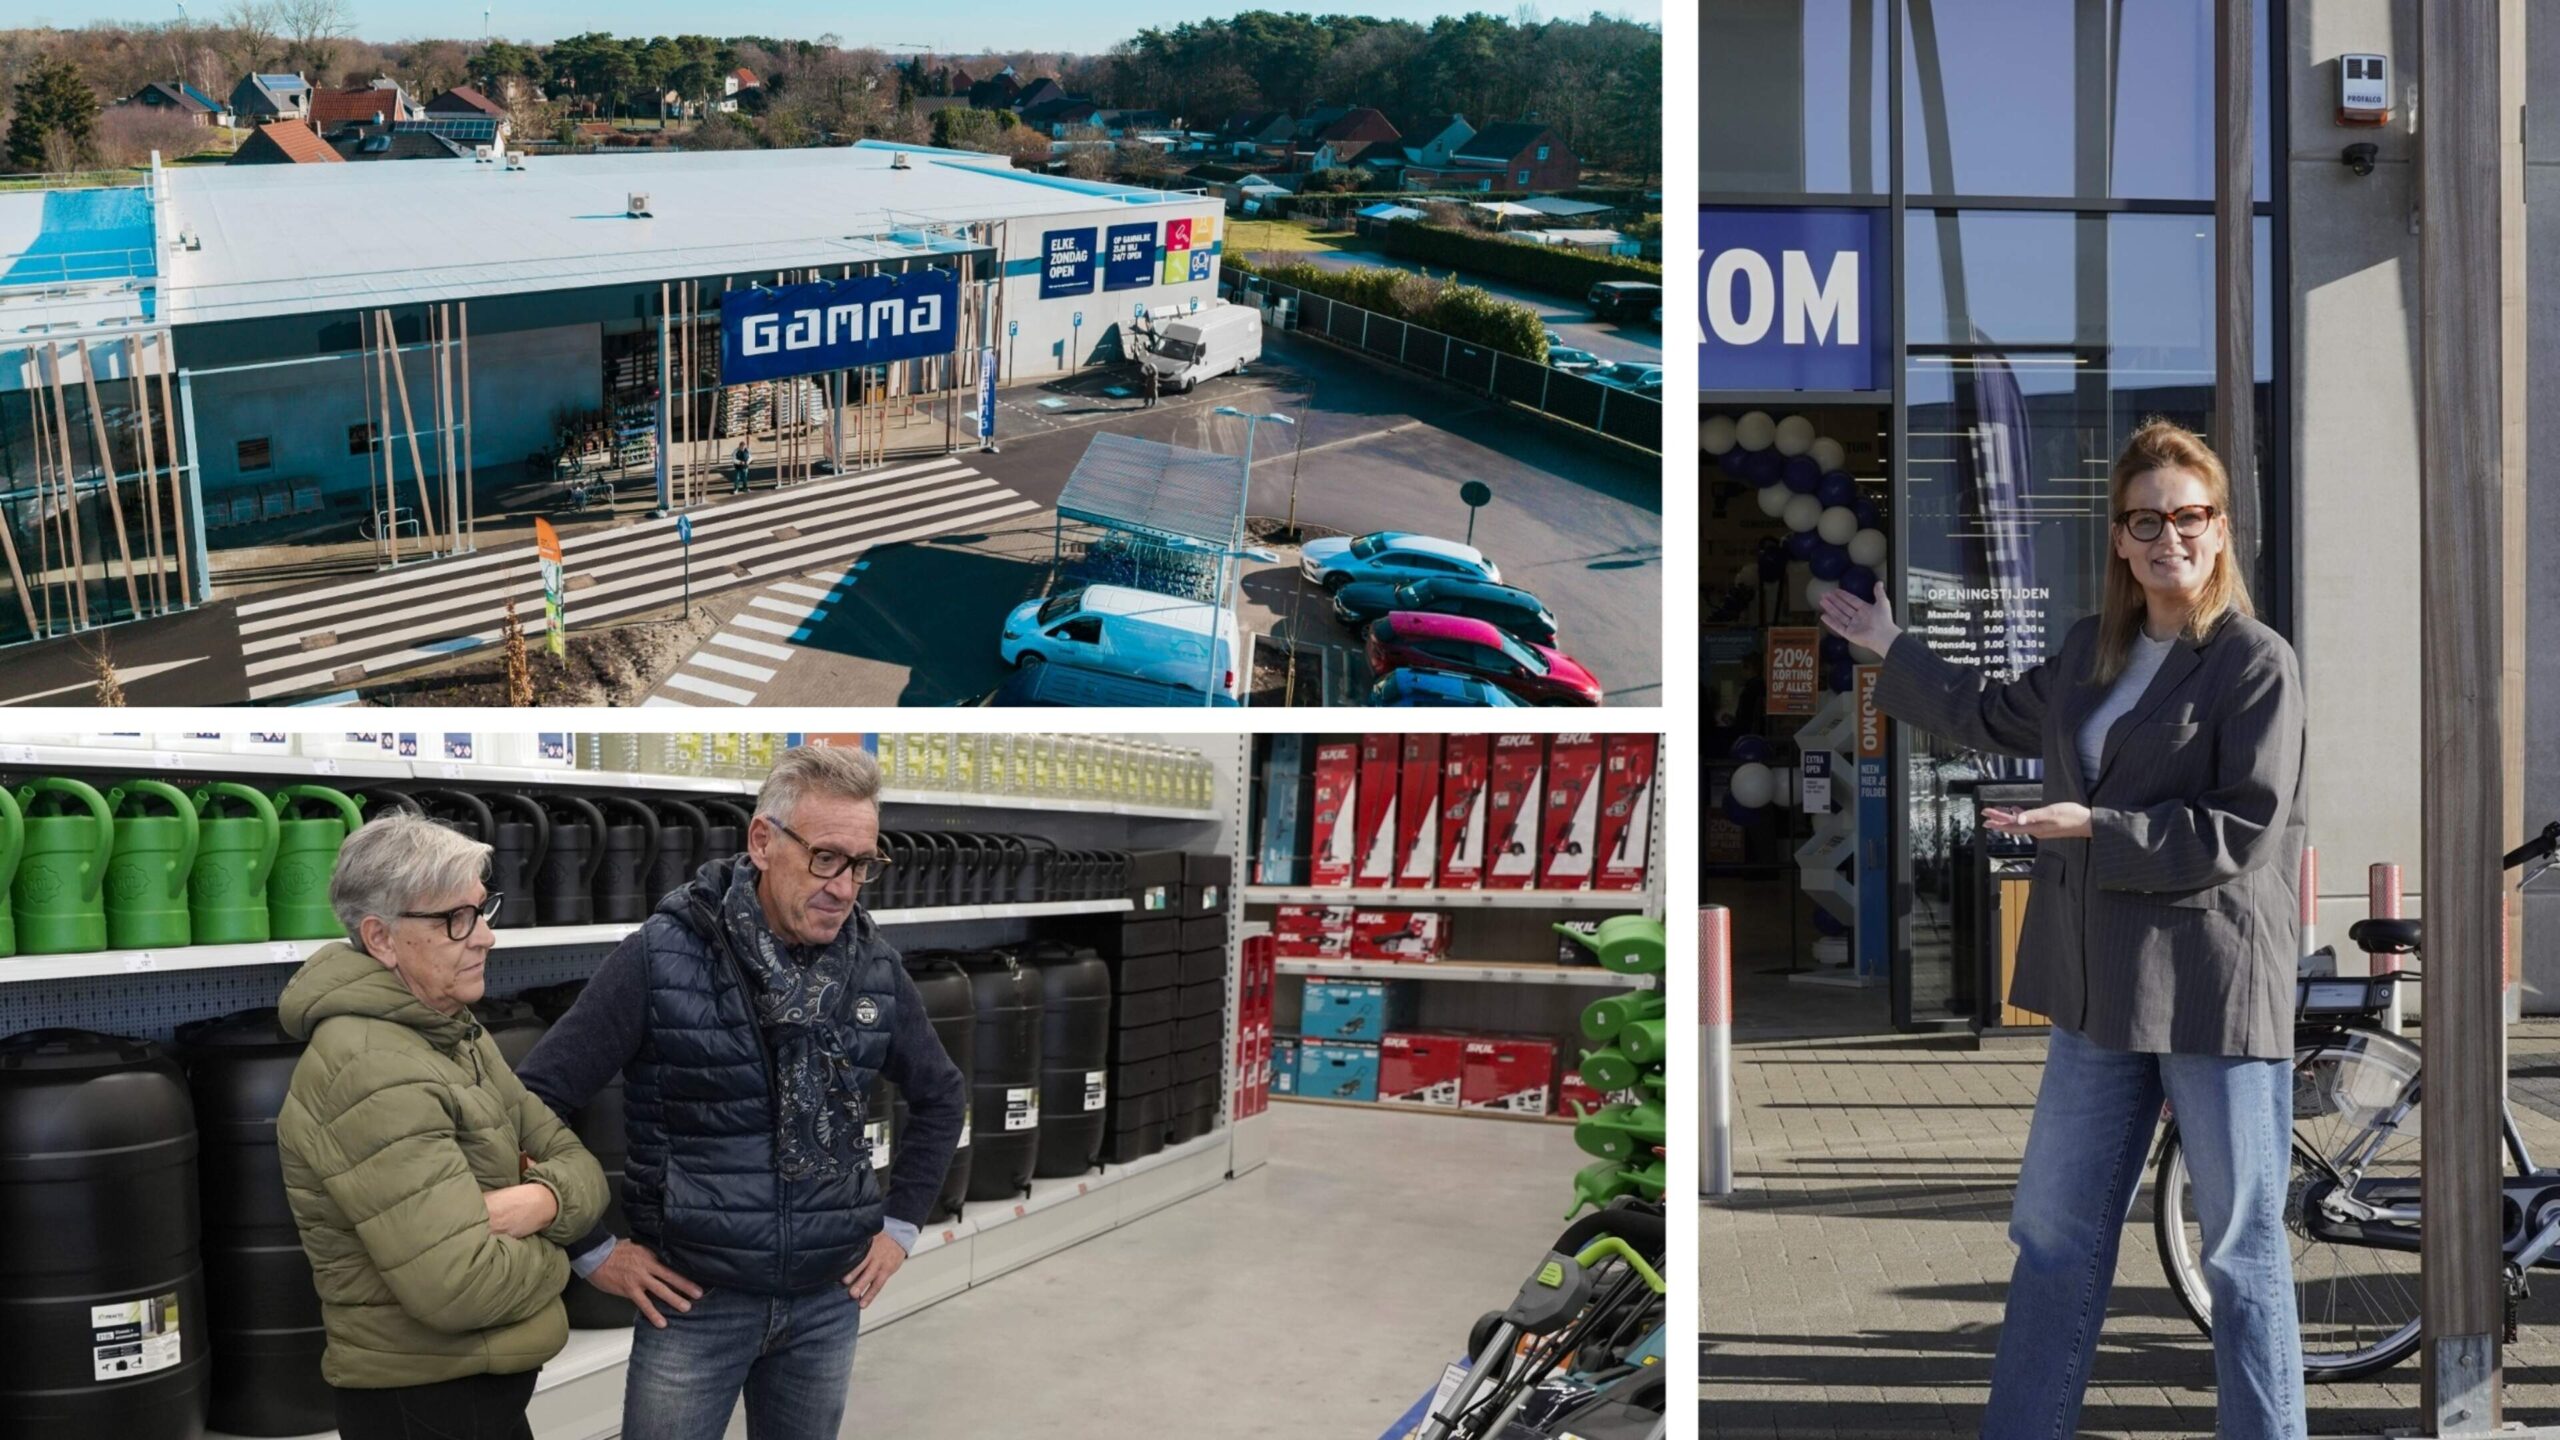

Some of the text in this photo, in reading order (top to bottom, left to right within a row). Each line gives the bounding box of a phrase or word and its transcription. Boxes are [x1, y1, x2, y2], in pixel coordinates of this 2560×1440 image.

[2347, 95, 2382, 103] PROFALCO
[1051, 238, 1075, 250] ELKE
[1113, 236, 1122, 245] OP
[1050, 250, 1088, 265] ZONDAG
[1112, 251, 1142, 262] 24/7 OPEN
[1049, 265, 1075, 279] OPEN
[1698, 247, 1860, 348] OM
[1927, 588, 2049, 600] OPENINGSTIJDEN
[1927, 610, 1971, 621] Maandag
[1983, 610, 2004, 618] 9.00
[2012, 610, 2037, 618] 18.30
[1927, 625, 1967, 636] Dinsdag
[1983, 625, 2004, 634] 9.00
[2012, 625, 2037, 634] 18.30
[1927, 640, 1977, 651] Woensdag
[1984, 640, 2005, 649] 9.00
[2012, 640, 2037, 648] 18.30
[1773, 648, 1813, 668] 20%
[1984, 655, 2005, 663] 9.00
[2012, 655, 2037, 663] 18.30
[1772, 669, 1813, 680] KORTING
[1772, 682, 1813, 693] OP ALLES
[1498, 734, 1534, 747] SKIL
[1556, 733, 1593, 744] SKIL
[1319, 750, 1349, 760] SKIL
[1806, 755, 1824, 764] EXTRA
[1806, 765, 1821, 774] OPEN
[1861, 776, 1887, 786] HIER JE
[1861, 787, 1887, 798] FOLDER
[1279, 907, 1302, 916] SKIL
[1356, 913, 1386, 924] SKIL
[1278, 933, 1301, 942] SKIL
[1383, 1038, 1410, 1048] SKIL
[1466, 1043, 1495, 1054] SKIL
[1563, 1075, 1584, 1086] SK
